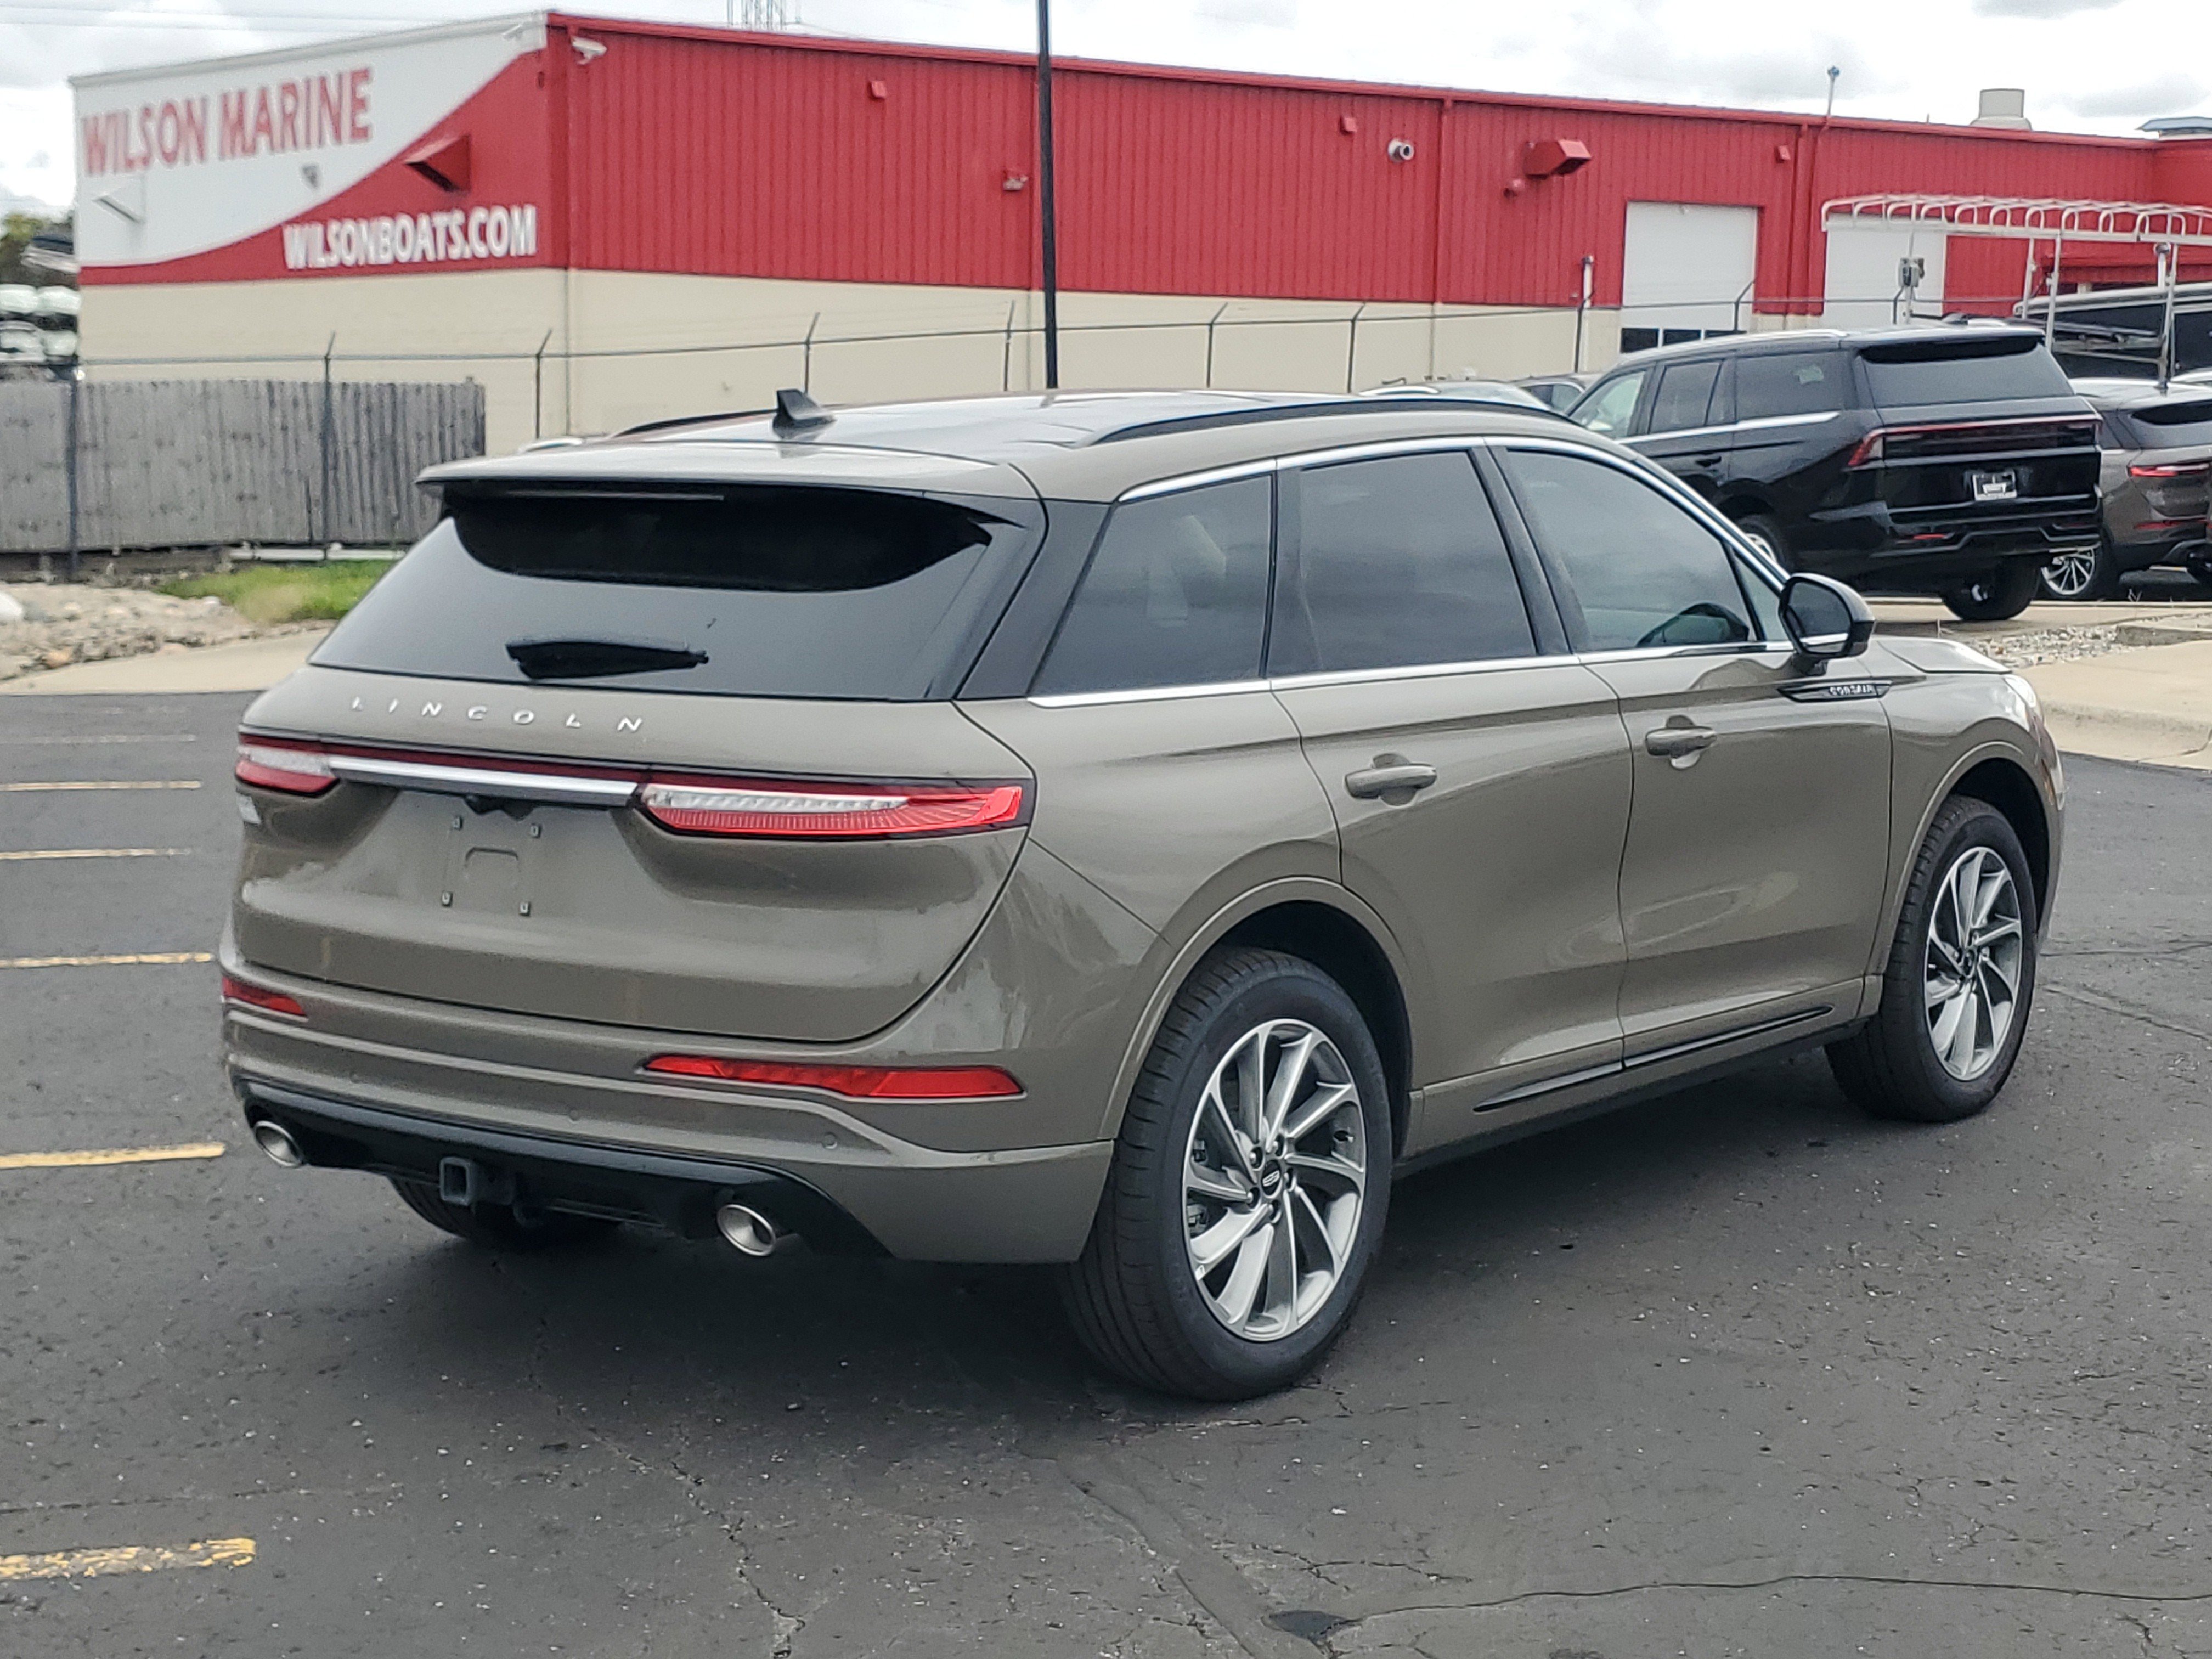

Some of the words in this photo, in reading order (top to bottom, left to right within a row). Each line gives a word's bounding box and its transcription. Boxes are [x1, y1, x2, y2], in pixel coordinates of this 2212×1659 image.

[83, 97, 208, 176] WILSON
[221, 67, 371, 159] MARINE
[284, 204, 537, 269] WILSONBOATS.COM
[352, 697, 642, 731] LINCOLN
